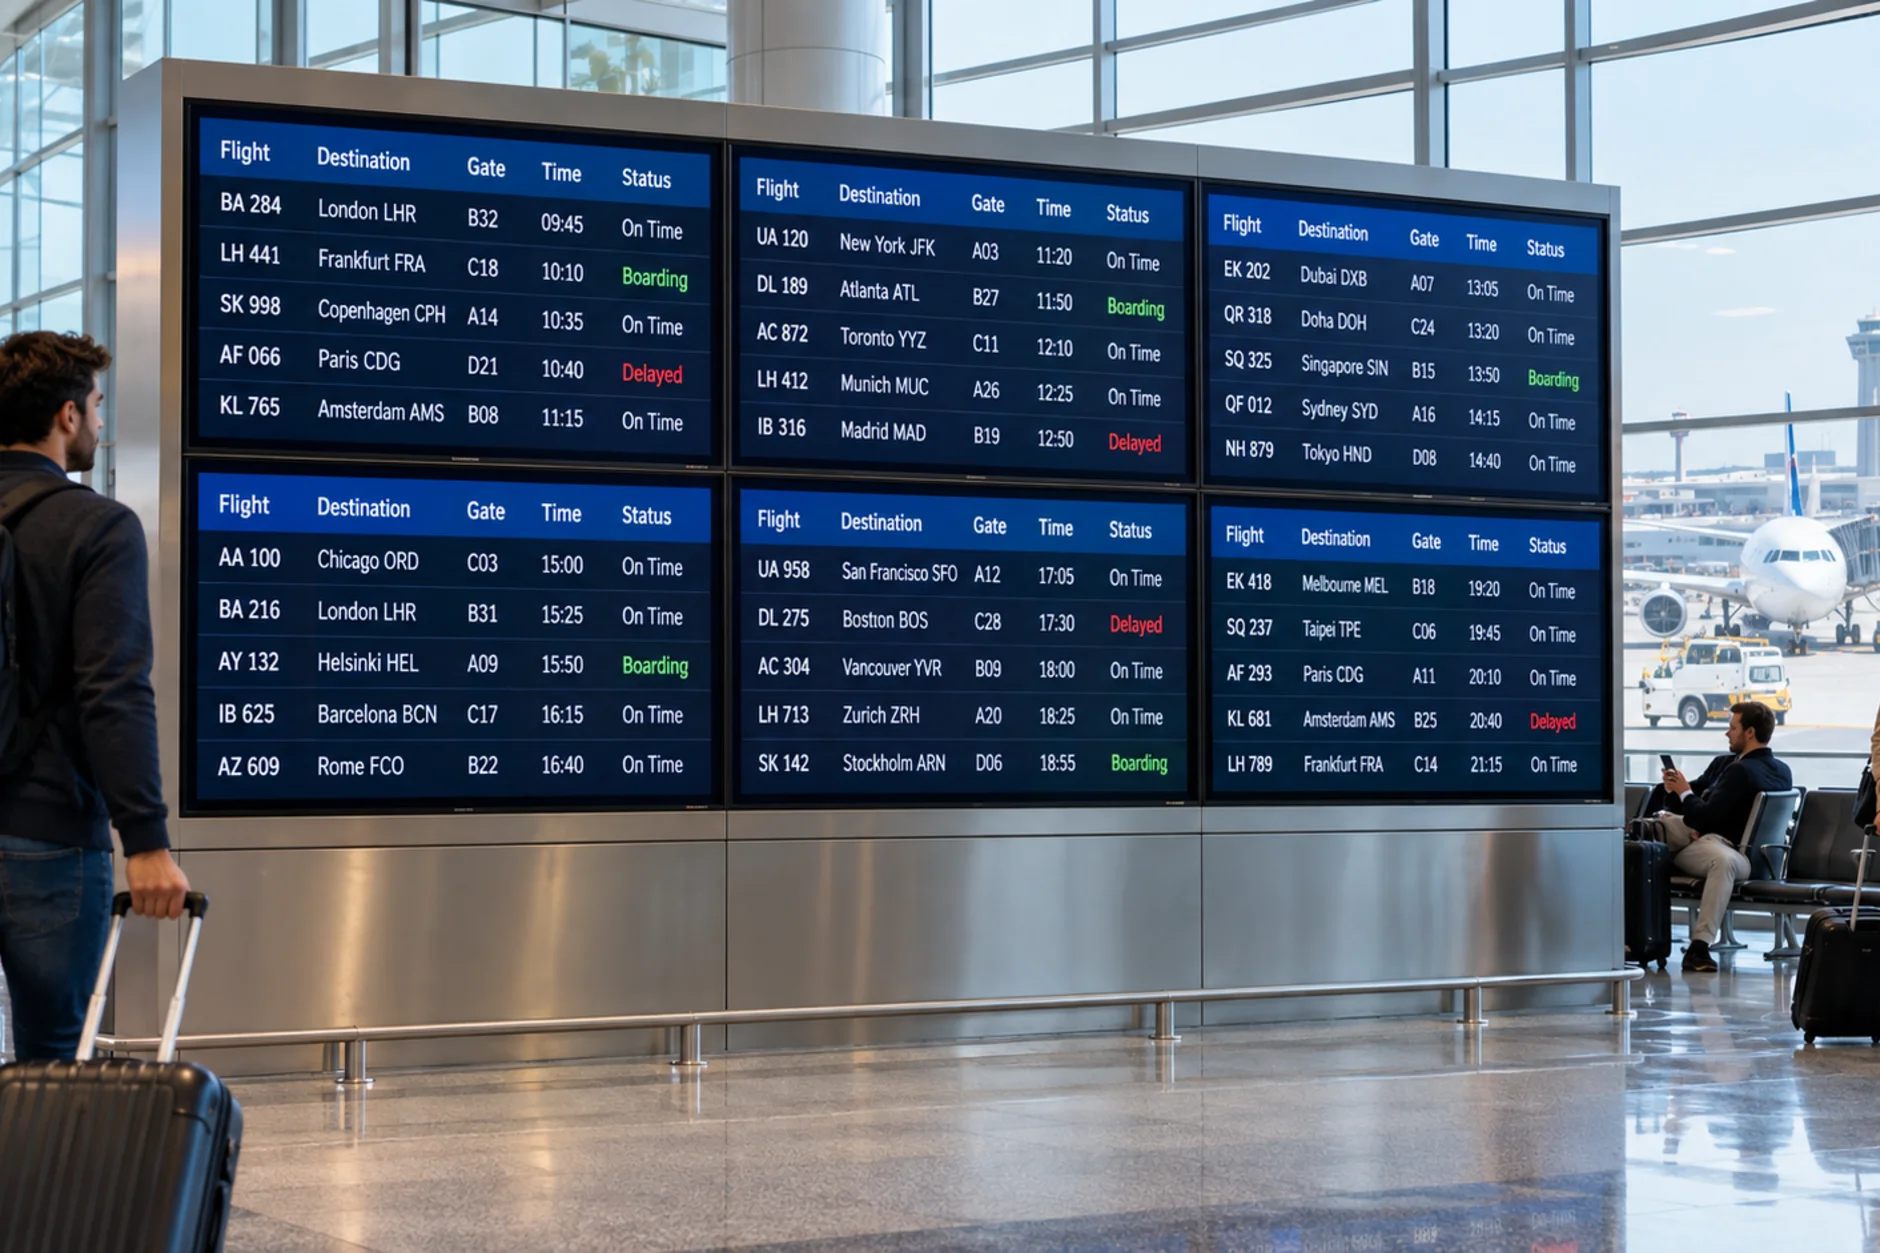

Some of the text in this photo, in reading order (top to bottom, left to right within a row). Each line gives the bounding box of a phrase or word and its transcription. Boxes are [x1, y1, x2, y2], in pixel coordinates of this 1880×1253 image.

[220, 139, 671, 188] Flight Destination Gate Time Status
[220, 191, 682, 240] BA 284 London LHR B32 09:45 On Time
[756, 177, 1149, 223] Flight Destination Gate Time Status
[1223, 213, 1564, 257] Flight Destination Gate Time Status
[220, 242, 687, 292] LH 441 Frankfurt FRA C18 10:10 Boarding
[1224, 259, 1574, 302] EK 202 Dubai DXB A07 13:05 On Time
[757, 274, 1165, 321] DL 189 Atlanta ATL B27 11:50 Boarding
[219, 344, 682, 387] AF 066 Paris CDG D21 10:40 Delayed
[1224, 349, 1579, 392] SQ 325 Singapore SIN B15 13:50 Boarding
[758, 416, 1161, 454] IB 316 Madrid MAD B19 12:50 Delayed
[1225, 439, 1575, 473] NH 879 Tokyo HND D08 14:40 On Time
[219, 493, 671, 525] Flight Destination Gate Time Status
[758, 509, 1152, 538] Flight Destination Gate Time Status
[1226, 525, 1566, 554] Flight Destination Gate Time Status
[218, 546, 682, 576] AA 100 Chicago ORD C03 15:00 On Time
[1226, 617, 1576, 642] SQ 237 Taipei TPE C06 19:45 On Time
[218, 650, 688, 679] AY 132 Helsinki HEL A09 15:50 Boarding
[758, 704, 1163, 725] LH 713 Zurich ZRH A20 18:25 On Time
[1227, 709, 1576, 733] KL 681 Amsterdam AMS B25 20:40 Delayed
[217, 754, 683, 776] AZ 609 Rome FCO B22 16:40 On Time
[758, 753, 1168, 775] SK 142 Stockholm ARN D06 18:55 Boarding
[1227, 754, 1577, 772] LH 789 Frankfurt FRA C14 21:15 On Time
